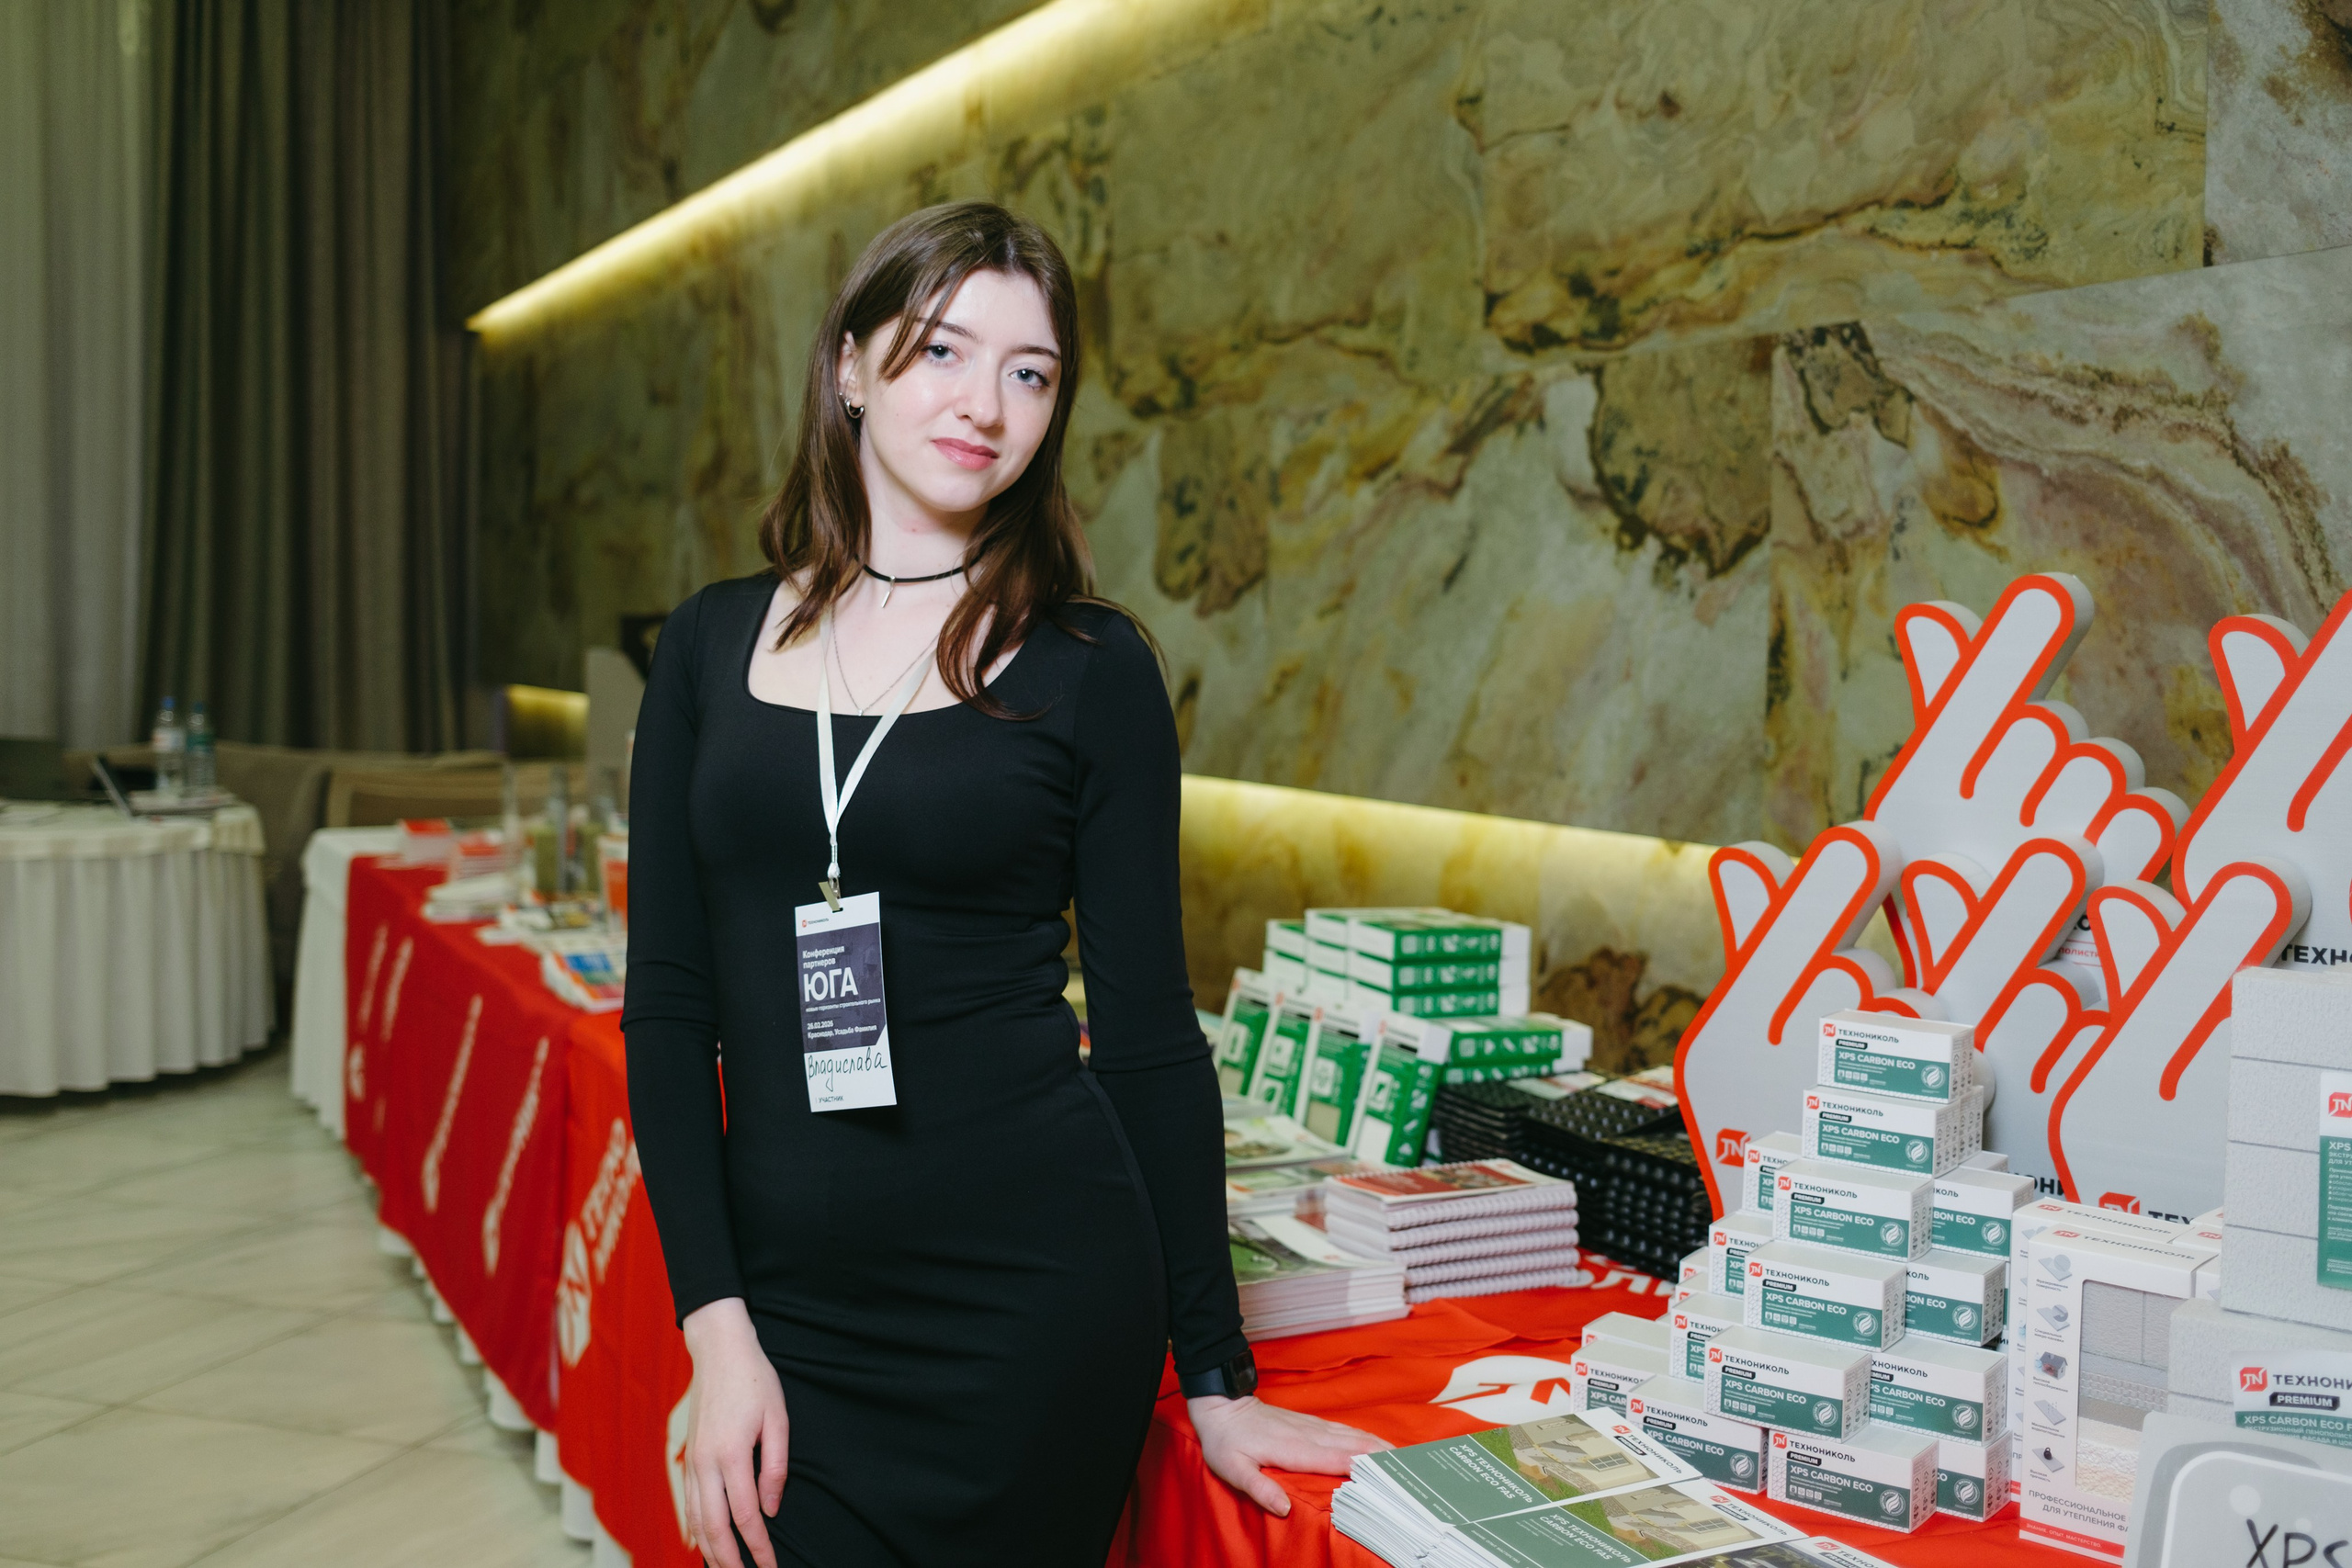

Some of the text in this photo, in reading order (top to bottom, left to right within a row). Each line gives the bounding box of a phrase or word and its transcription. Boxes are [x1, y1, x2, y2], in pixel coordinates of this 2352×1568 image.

[803, 946, 845, 959] Конференция
[803, 957, 836, 969] партнеров
[804, 967, 858, 1002] ЮГА
[1838, 1029, 1899, 1043] ТЕХНОНИКОЛЬ
[1838, 1040, 1865, 1049] PREMIUM
[808, 1047, 888, 1092] Владислава
[1838, 1051, 1856, 1061] XPS
[1858, 1055, 1894, 1067] CARBON
[1896, 1060, 1916, 1069] ECO
[1822, 1113, 1849, 1122] PREMIUM
[1823, 1101, 1883, 1117] ТЕХНОНИКОЛЬ
[1823, 1124, 1839, 1134] XPS
[1841, 1128, 1878, 1141] CARBON
[1882, 1134, 1900, 1144] ECO
[2329, 1141, 2351, 1151] XPS
[1793, 1181, 1858, 1198] ТЕХНОНИКОЛЬ
[1793, 1194, 1822, 1203] PREMIUM
[1793, 1205, 1812, 1215] XPS
[1814, 1209, 1852, 1223] CARBON
[1855, 1216, 1874, 1226] ECO
[1956, 1213, 1975, 1224] ECO
[2067, 1210, 2171, 1235] ТЕХНОНИКОЛЬ
[2084, 1235, 2194, 1260] ТЕХНОНИКОЛЬ
[1766, 1269, 1830, 1286] ТЕХНОНИКОЛЬ
[1766, 1280, 1793, 1290] PREMIUM
[1766, 1292, 1783, 1303] XPS
[1786, 1297, 1825, 1311] CARBON
[1827, 1304, 1847, 1315] ECO
[1927, 1299, 1946, 1309] ECO
[1724, 1354, 1790, 1375] ТЕХНОНИКОЛЬ
[1725, 1367, 1752, 1378] PREMIUM
[1590, 1392, 1607, 1401] XPS
[1724, 1380, 1742, 1390] XPS
[1745, 1383, 1784, 1400] CARBON
[1787, 1393, 1806, 1404] ECO
[1883, 1387, 1923, 1402] CARBON
[1926, 1395, 1945, 1407] ECO
[2277, 1395, 2333, 1407] PREMIUM
[1646, 1405, 1708, 1427] ТЕХНОНИКОЛЬ
[1646, 1418, 1673, 1429] PREMIUM
[2268, 1416, 2317, 1427] CARBON
[2320, 1420, 2344, 1430] ECO
[1646, 1429, 1724, 1456] XPS CARBON ECO
[1790, 1440, 1855, 1462] ТЕХНОНИКОЛЬ
[1628, 1435, 1681, 1473] ТЕХНОНИКОЛЬ
[1790, 1453, 1818, 1465] PREMIUM
[1449, 1447, 1487, 1473] CARBON
[1480, 1471, 1499, 1486] ECO
[1498, 1485, 1516, 1499] FAS
[1459, 1444, 1477, 1459] XPS
[1476, 1456, 1532, 1504] ТЕХНОНИКОЛЬ
[1791, 1465, 1809, 1477] XPS
[1811, 1471, 1850, 1488] CARBON
[1853, 1481, 1873, 1493] ECO
[2029, 1490, 2126, 1522] ПРОФЕССИОНАЛЬНОЕ
[1727, 1503, 1787, 1536] ТЕХНОНИКОЛЬ
[2042, 1504, 2061, 1515] ДЛЯ
[2064, 1509, 2115, 1529] УТЕПЛЕНИЯ
[1540, 1516, 1577, 1539] CARBON
[1574, 1538, 1593, 1550] ECO
[1593, 1548, 1612, 1560] FAS
[1550, 1514, 1569, 1526] XPS
[1568, 1524, 1632, 1563] ТЕХНОНИКОЛЬ
[2066, 1533, 2102, 1548] МАСТЕРСТВО.
